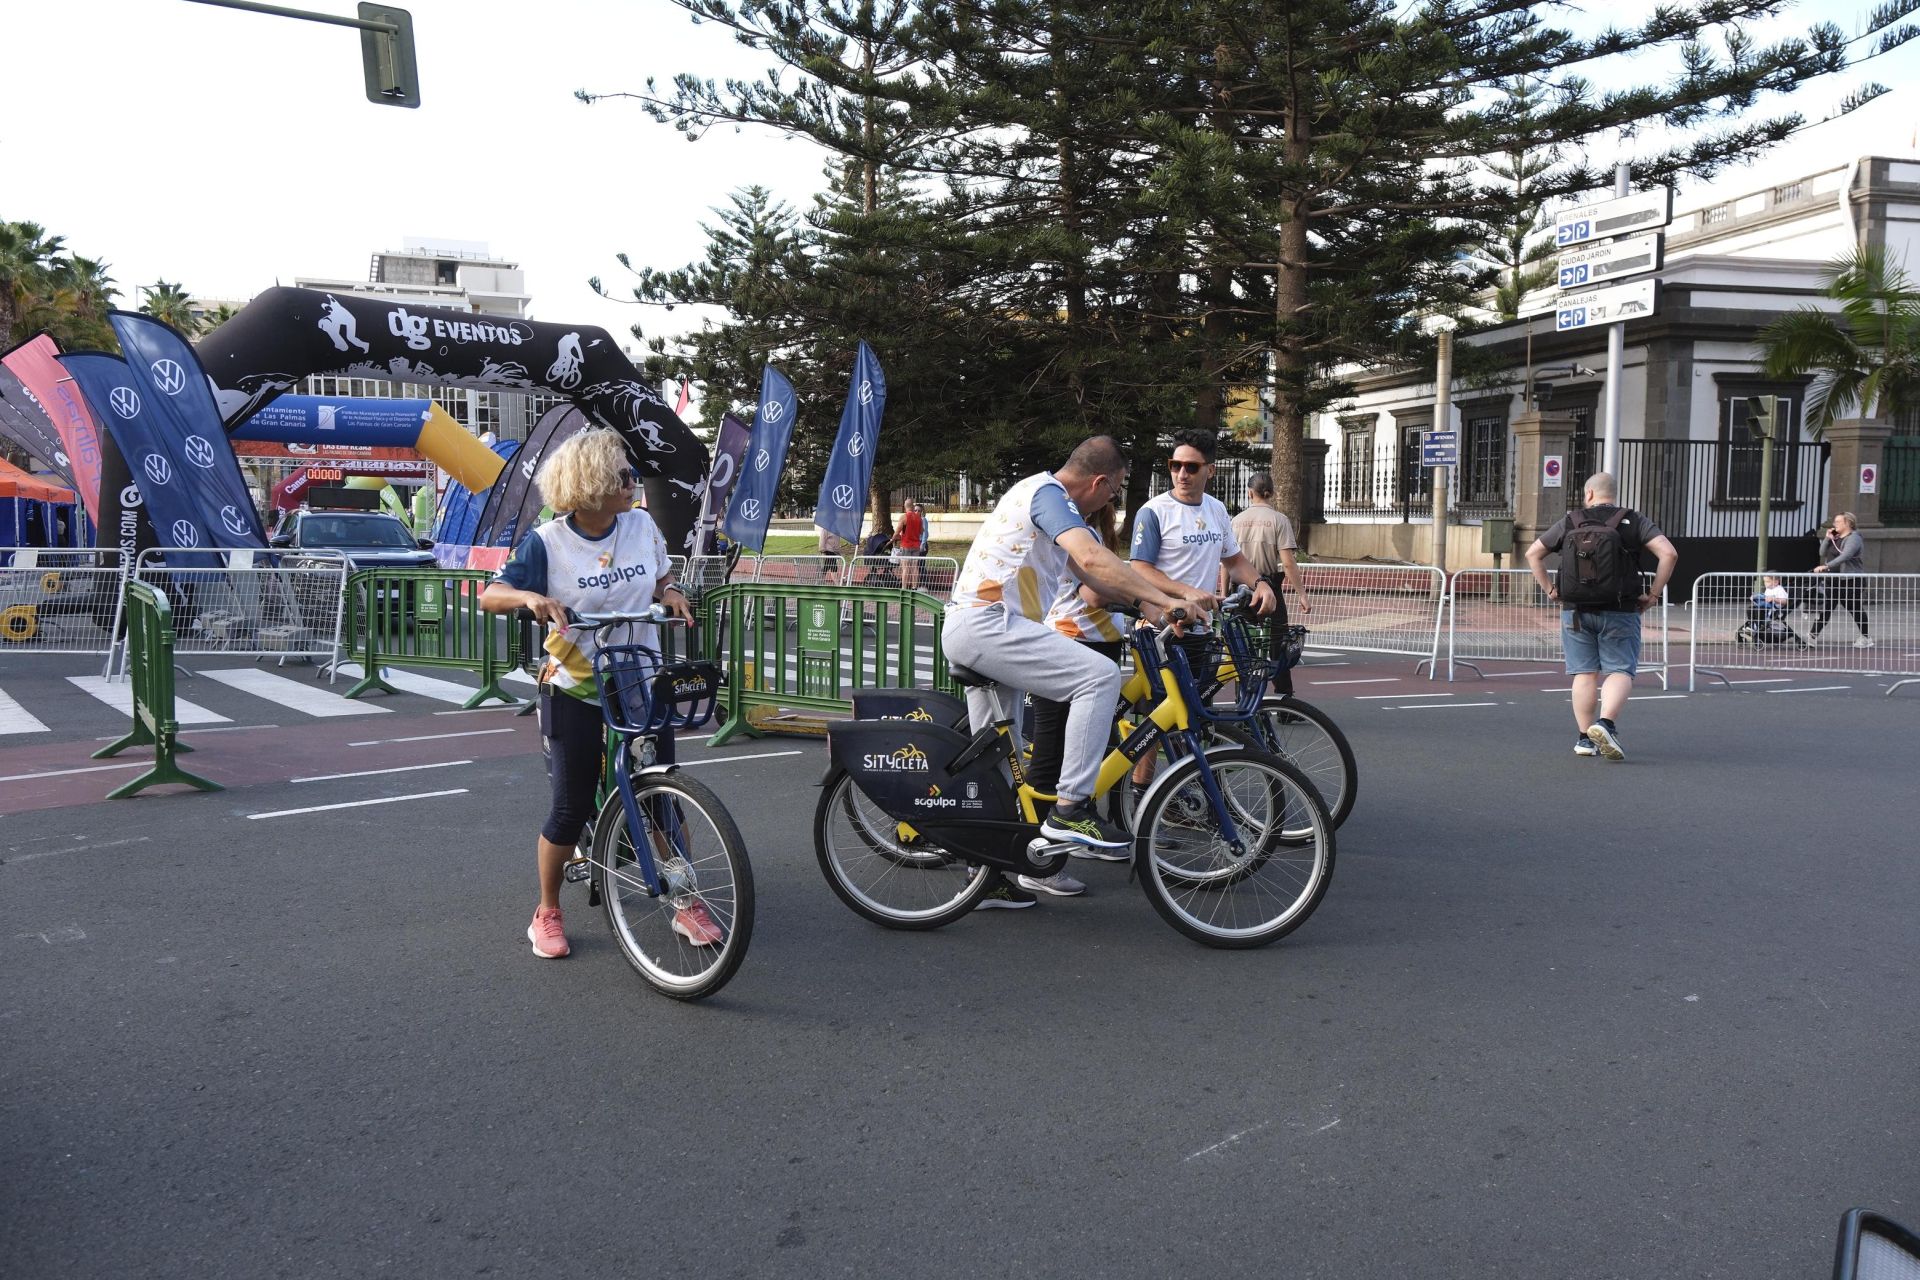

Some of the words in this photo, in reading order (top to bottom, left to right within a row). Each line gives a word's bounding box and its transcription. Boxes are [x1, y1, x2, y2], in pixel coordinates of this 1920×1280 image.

[1560, 208, 1598, 222] ARENALES
[1561, 254, 1585, 266] CIUDAD
[1559, 294, 1598, 308] CANALEJAS
[433, 319, 522, 345] EVENTOS
[280, 413, 306, 421] Palmas
[577, 564, 647, 589] sagulpa
[1134, 728, 1158, 753] sagulpa
[1010, 757, 1024, 784] 410387
[914, 797, 956, 808] sagulpa
